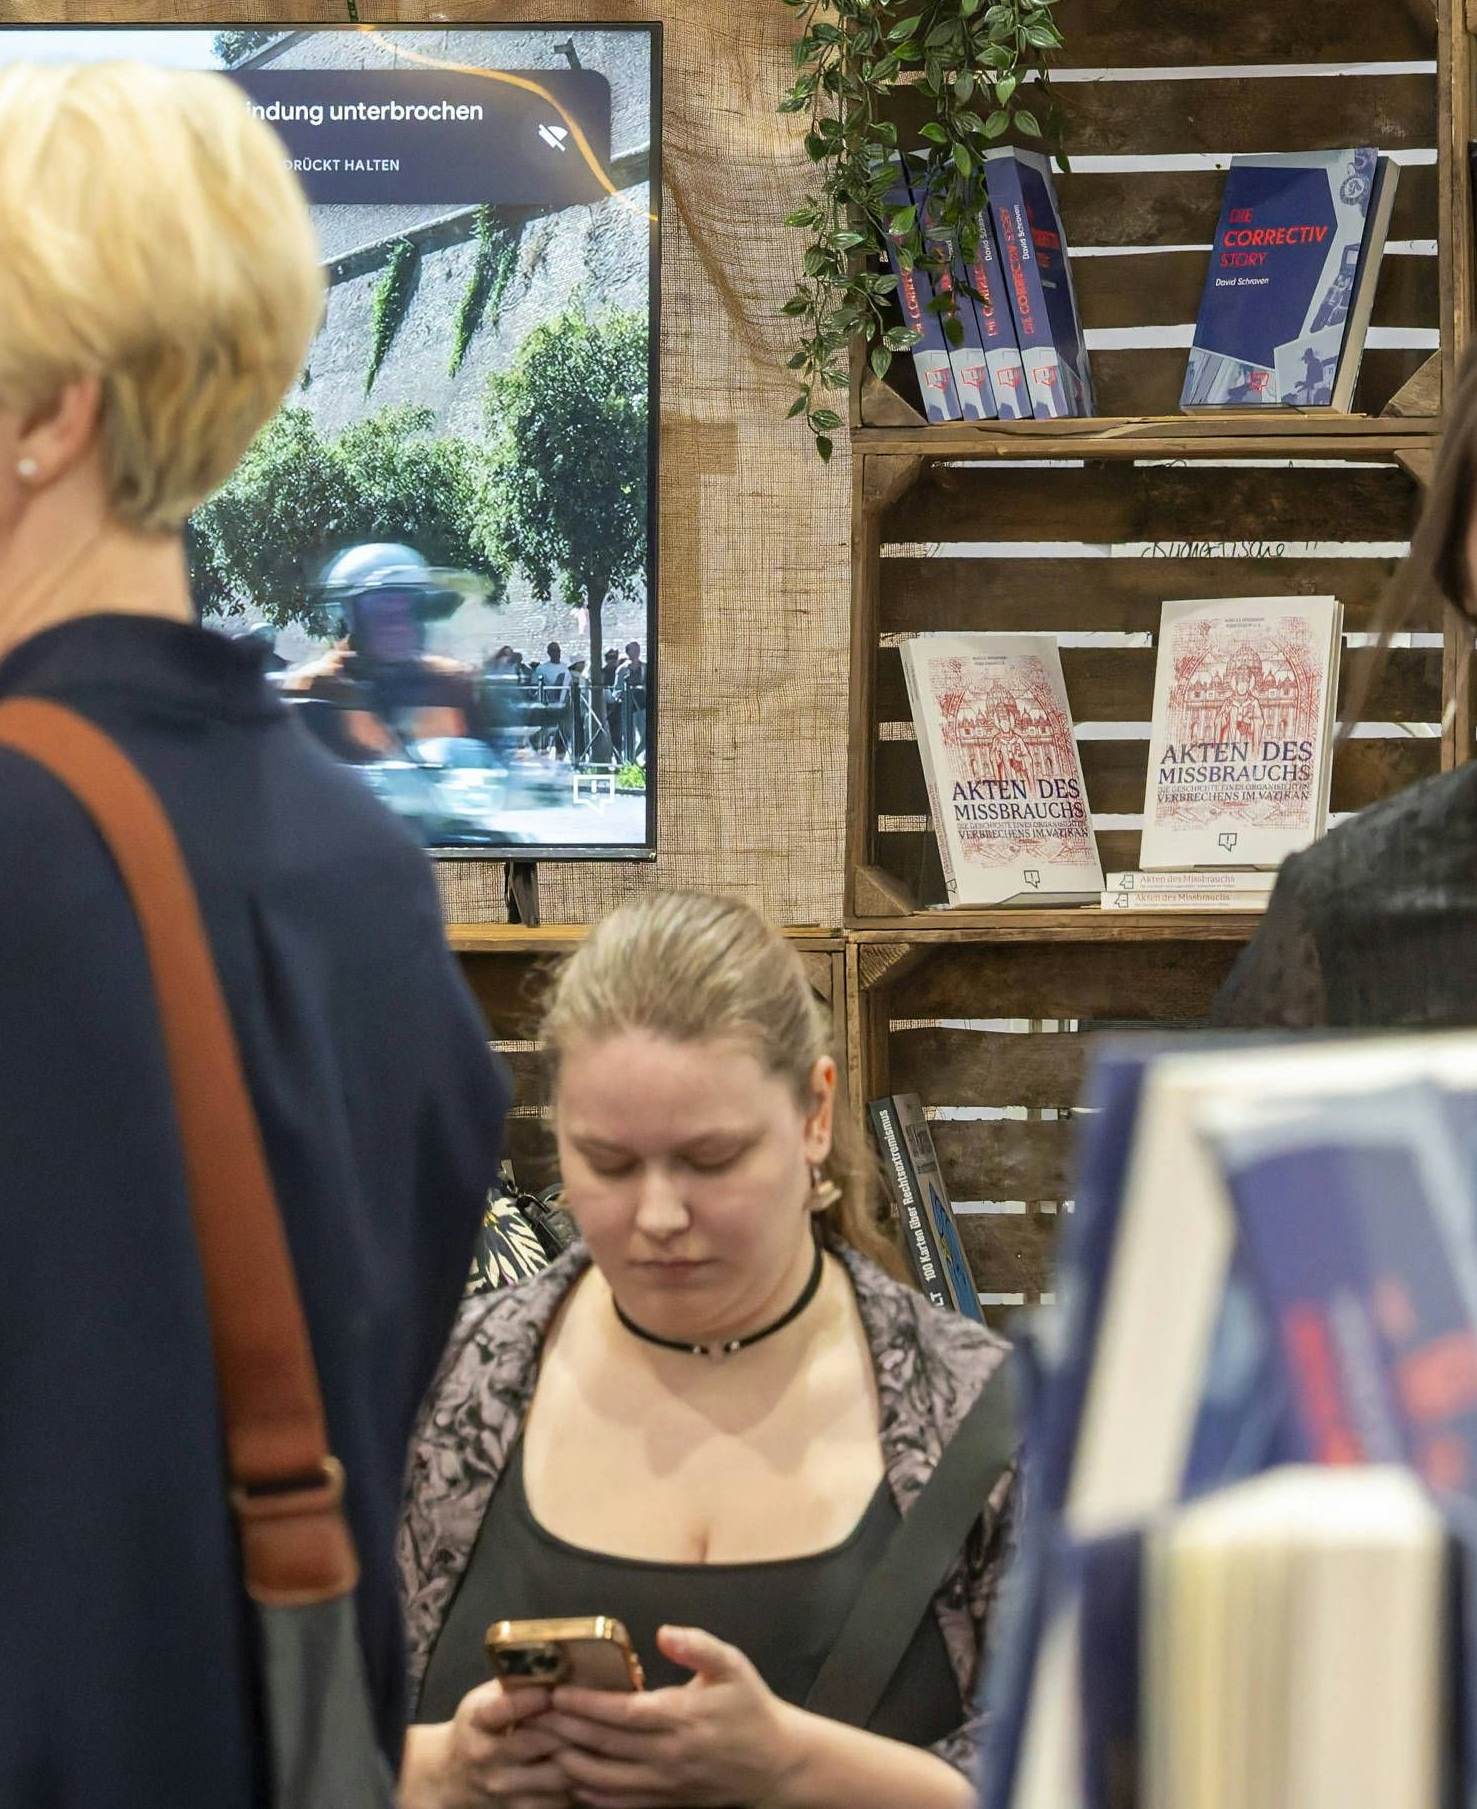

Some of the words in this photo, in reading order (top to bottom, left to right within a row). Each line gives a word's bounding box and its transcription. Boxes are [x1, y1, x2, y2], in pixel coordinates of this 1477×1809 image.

[246, 101, 323, 125] indung
[330, 101, 483, 121] unterbrochen
[284, 158, 340, 171] DRÜCKT
[345, 159, 400, 171] HALTEN
[1230, 209, 1253, 223] DIE
[1224, 225, 1327, 248] CORRECTIV
[1220, 252, 1267, 268] STORY
[1216, 278, 1236, 288] David
[1238, 276, 1269, 286] Schraven
[1160, 742, 1249, 765] AKTEN
[1262, 741, 1312, 761] DES
[1158, 764, 1311, 784] MISSBRAUCHS
[951, 780, 1027, 801] AKTEN
[1037, 779, 1080, 798] DES
[1157, 792, 1238, 803] VERBRECHENS
[1242, 791, 1256, 801] IM
[1259, 790, 1308, 801] VATIKAN
[953, 802, 1083, 821] MISSBRAUCHS
[879, 1108, 915, 1206] Rechtsextremismus
[915, 1227, 933, 1262] Karten
[922, 1261, 937, 1282] 100
[928, 1291, 945, 1310] LT
